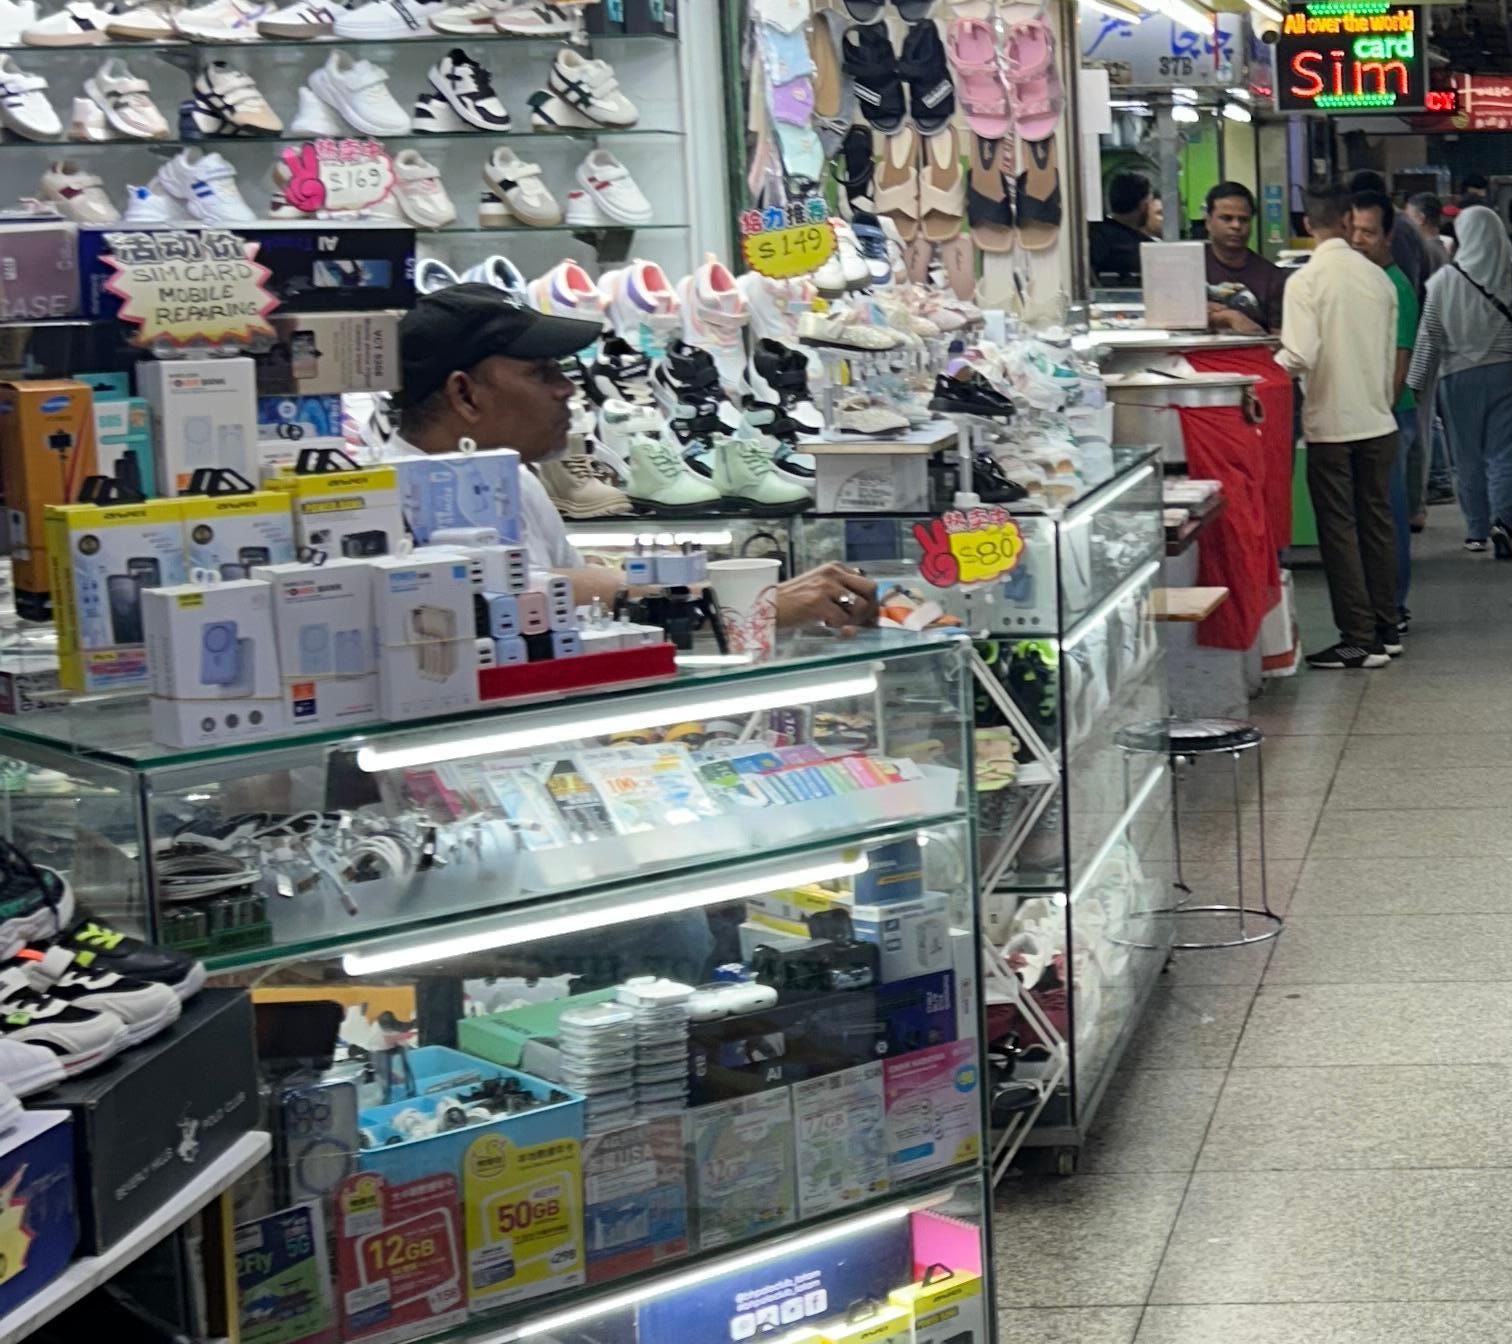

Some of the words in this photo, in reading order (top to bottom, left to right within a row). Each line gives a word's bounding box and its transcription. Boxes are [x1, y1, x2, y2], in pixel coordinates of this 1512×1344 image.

[1284, 13, 1307, 35] All
[1306, 16, 1341, 34] over
[1341, 13, 1369, 33] the
[1369, 9, 1414, 32] world
[1353, 31, 1415, 59] card
[1290, 50, 1409, 97] Sim
[133, 265, 180, 282] SIM
[184, 263, 252, 282] CARD
[159, 285, 234, 303] MOBILE
[498, 1199, 560, 1233] 50GB
[370, 1235, 435, 1269] 12GB
